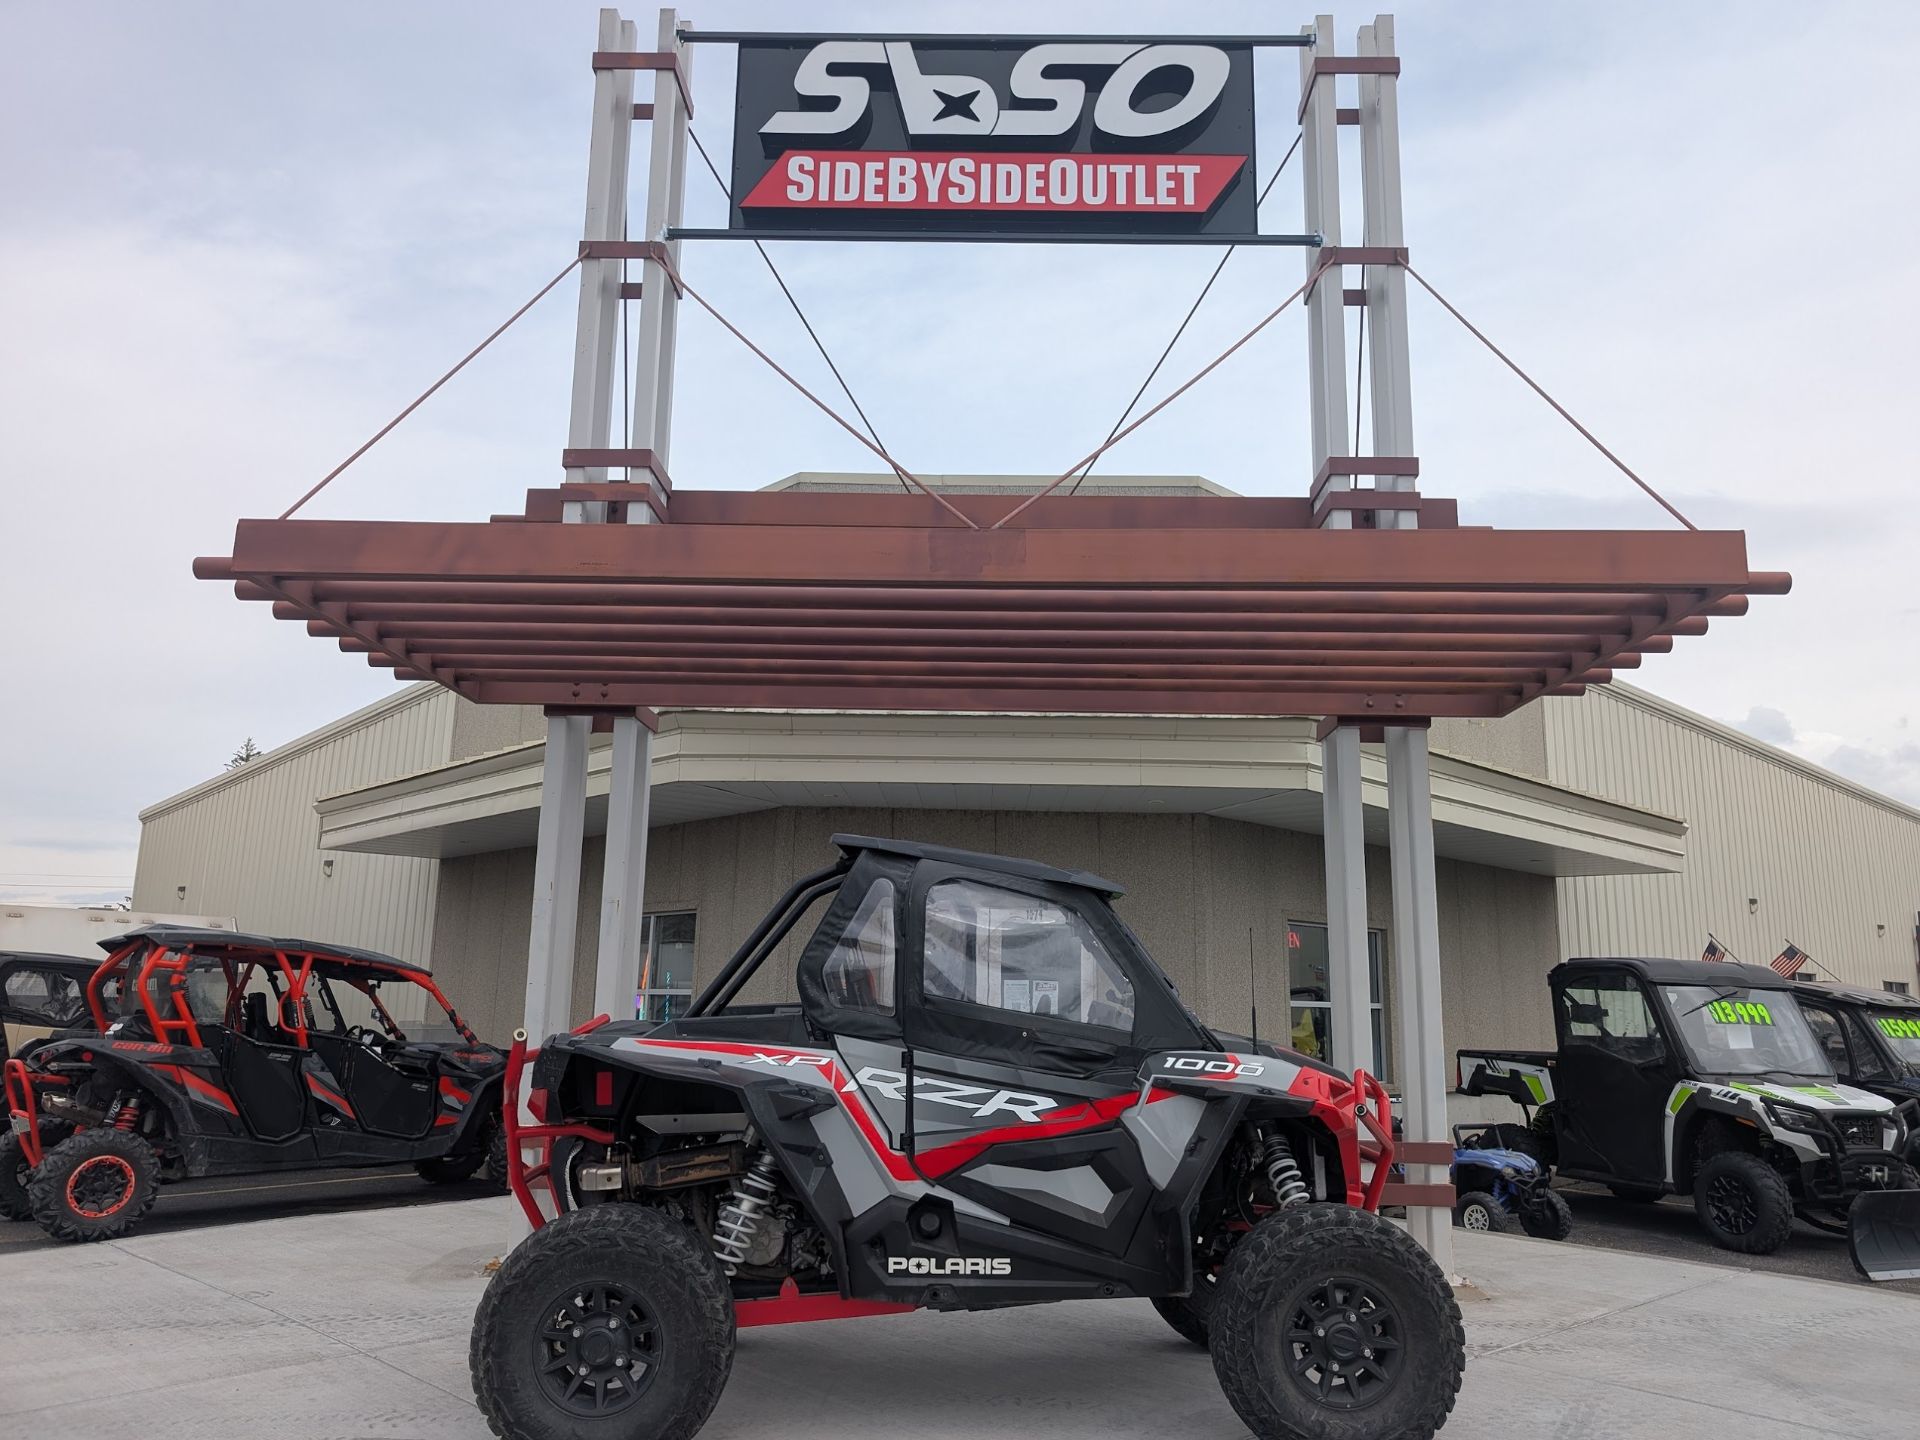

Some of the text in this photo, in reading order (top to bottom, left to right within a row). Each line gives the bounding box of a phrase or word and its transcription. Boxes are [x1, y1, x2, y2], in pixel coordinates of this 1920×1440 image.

[1876, 1018, 1920, 1038] $1599
[748, 1053, 832, 1066] XP
[1163, 1057, 1265, 1077] 1000
[840, 1066, 1058, 1123] RZR
[887, 1256, 1012, 1275] POLARIS
